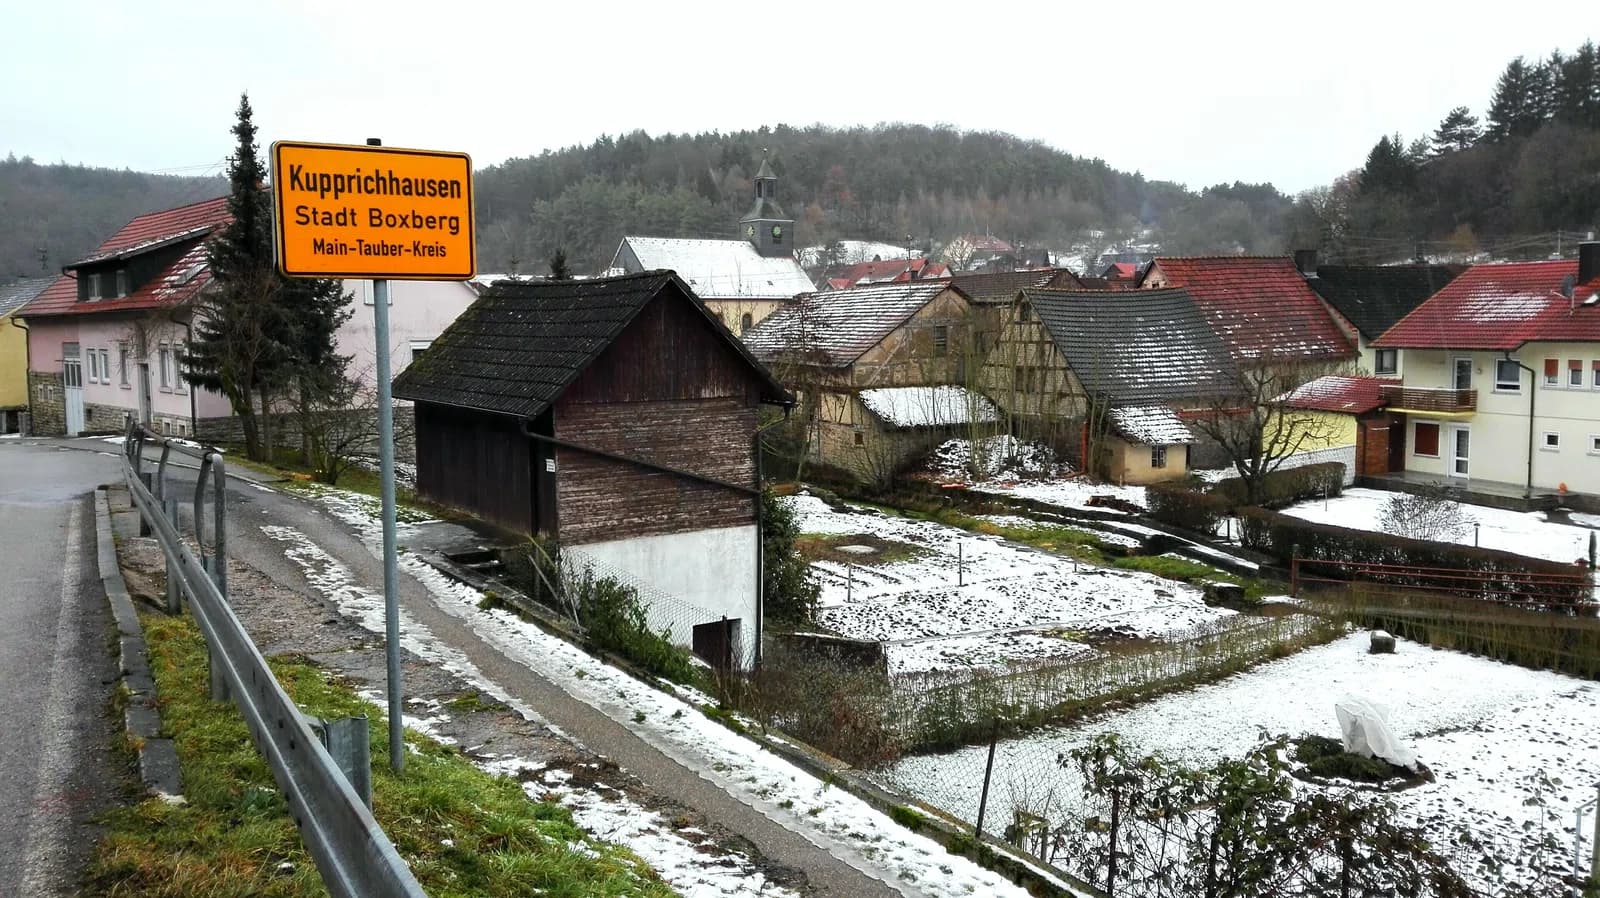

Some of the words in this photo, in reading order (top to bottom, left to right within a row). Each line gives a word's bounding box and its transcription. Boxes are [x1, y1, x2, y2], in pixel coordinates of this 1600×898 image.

[289, 164, 461, 199] Kupprichhausen
[295, 205, 357, 227] Stadt
[368, 207, 460, 236] Boxberg
[313, 237, 447, 257] Main-Tauber-Kreis
